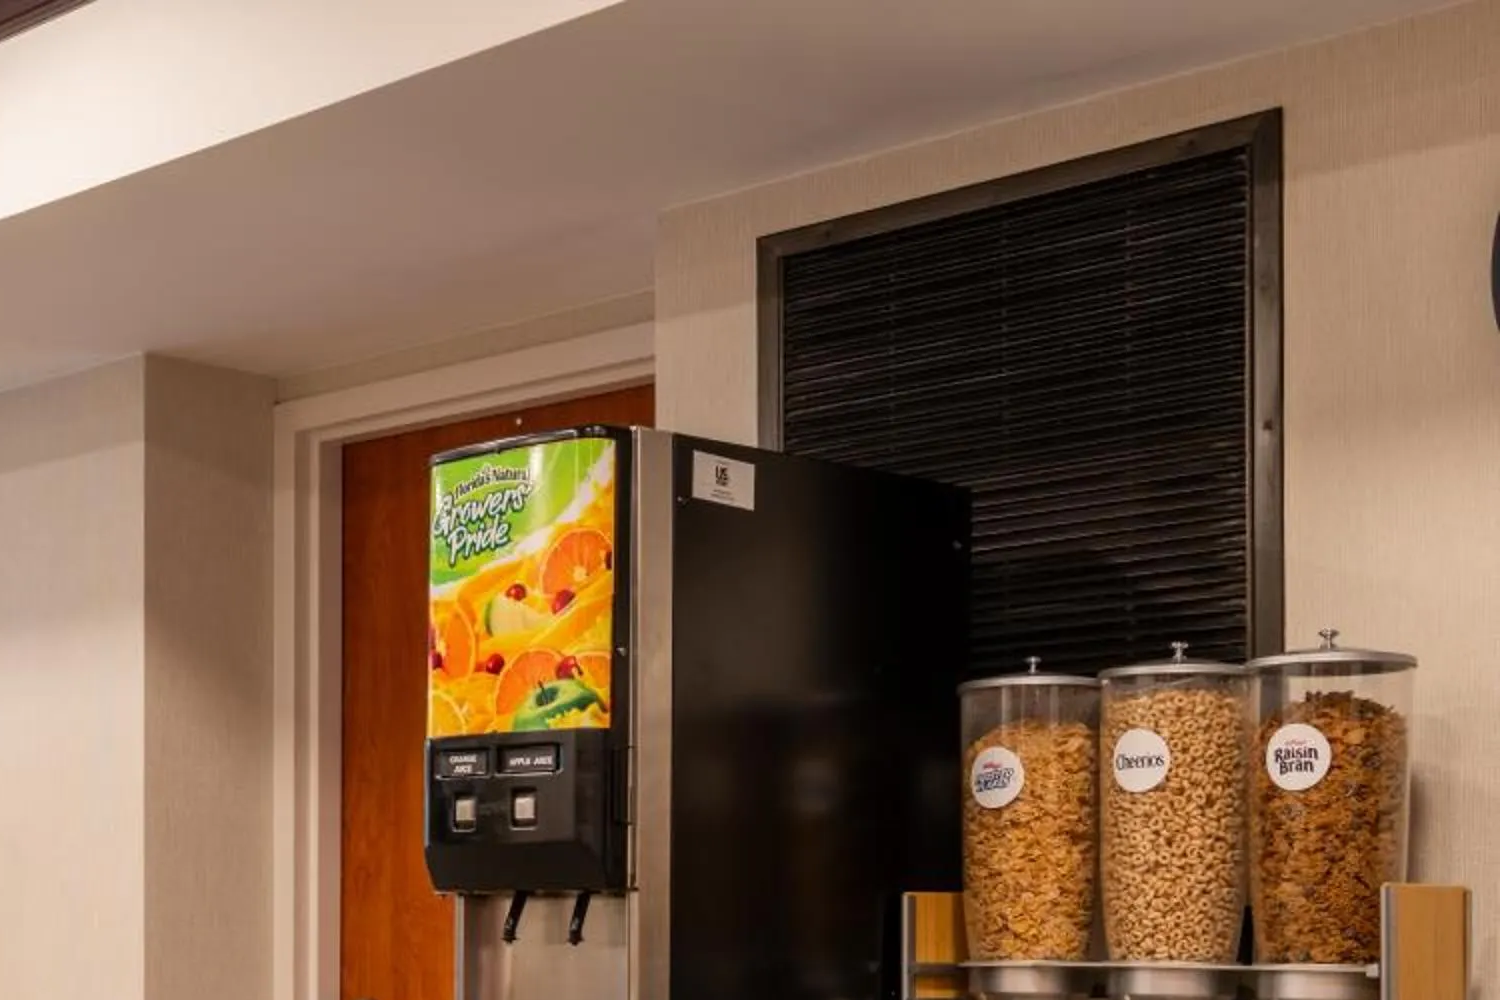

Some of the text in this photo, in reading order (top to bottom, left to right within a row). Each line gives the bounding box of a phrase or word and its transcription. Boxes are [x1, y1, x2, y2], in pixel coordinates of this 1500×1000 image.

[447, 514, 511, 567] Pride
[1115, 753, 1165, 771] Cheerios
[1274, 746, 1319, 763] Raisin
[1279, 760, 1315, 776] Bran
